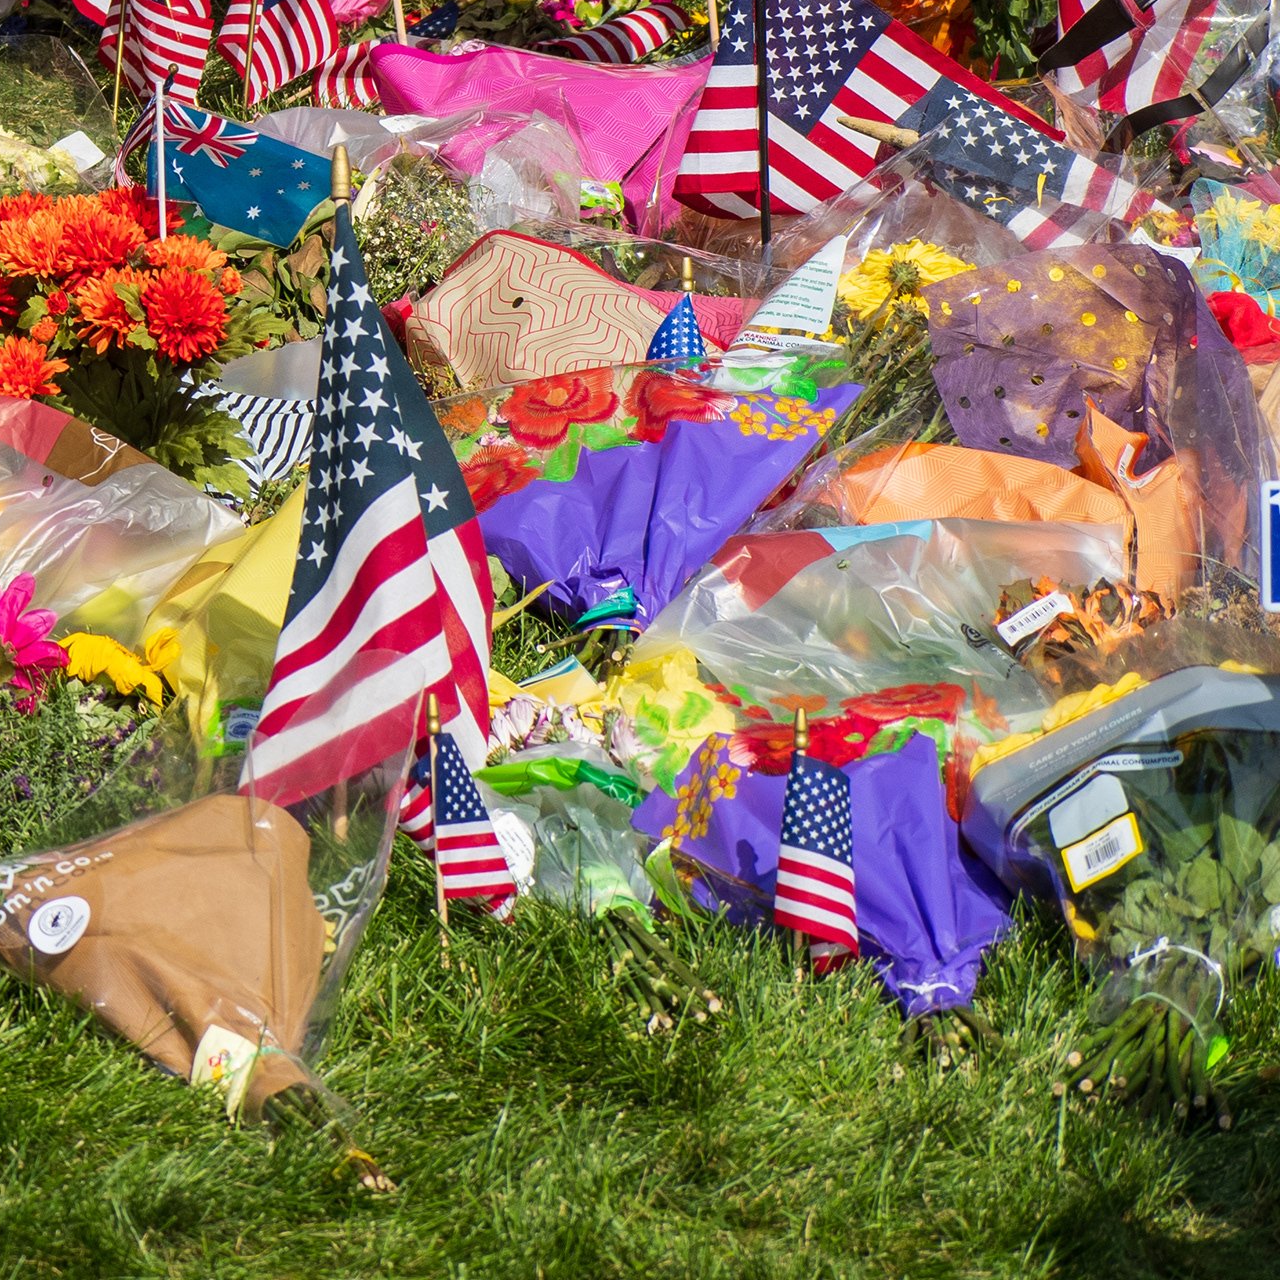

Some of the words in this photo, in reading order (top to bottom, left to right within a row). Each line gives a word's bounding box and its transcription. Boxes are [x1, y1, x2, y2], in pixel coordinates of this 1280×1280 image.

[756, 338, 784, 348] ANIMAL
[1029, 753, 1054, 769] CARE
[1055, 743, 1070, 755] OF
[1071, 731, 1097, 747] YOUR
[1098, 708, 1143, 734] FLOWERS
[1091, 759, 1120, 771] ANIMAL
[1122, 755, 1180, 766] CONSUMPTION
